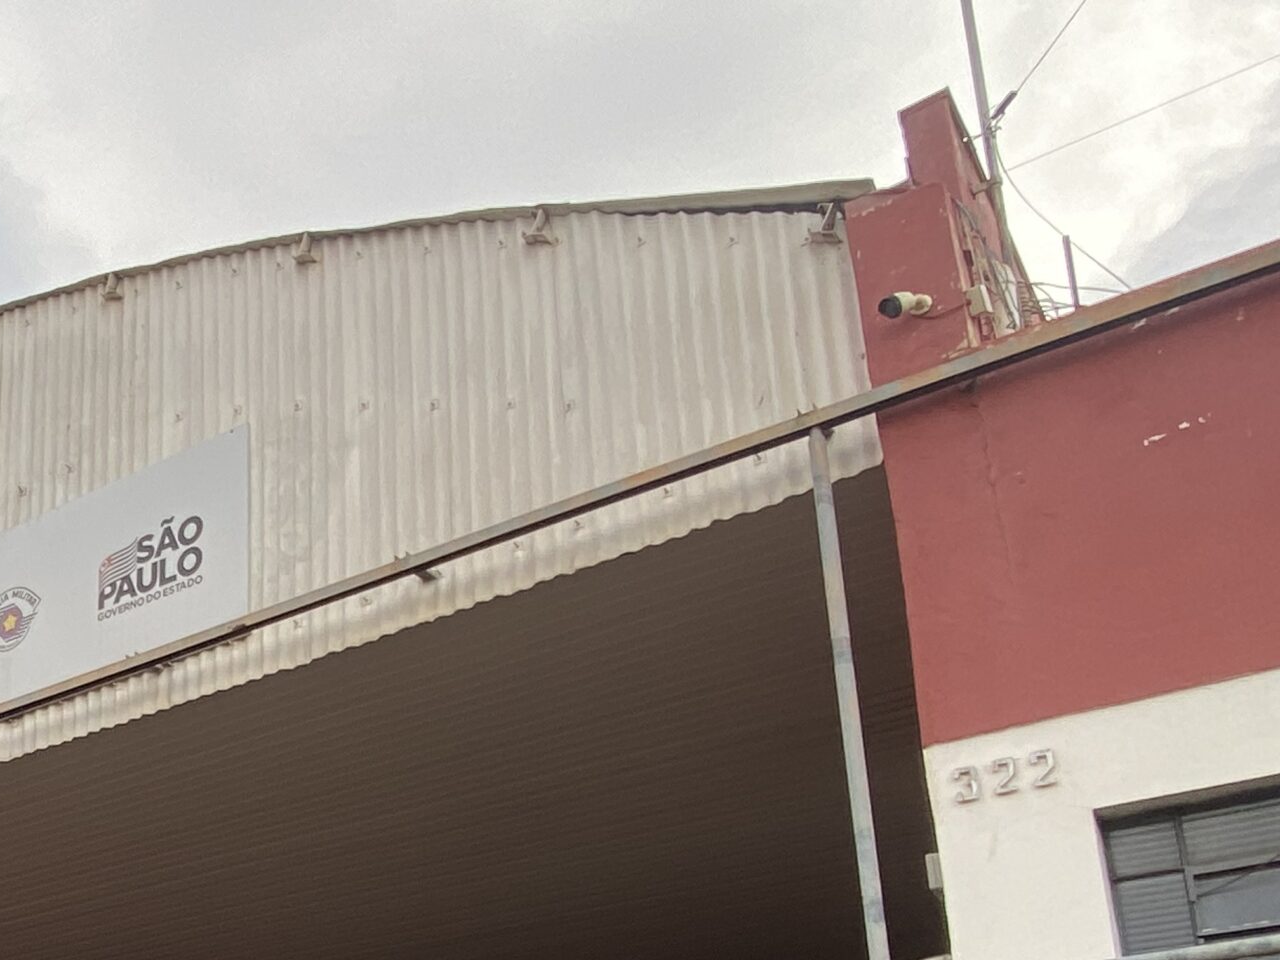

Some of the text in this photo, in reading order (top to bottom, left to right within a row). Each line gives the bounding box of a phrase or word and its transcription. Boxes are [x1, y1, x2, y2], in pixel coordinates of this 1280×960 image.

[136, 515, 204, 564] SÃO
[97, 575, 204, 622] GOVERNO DO ESTADO
[98, 546, 203, 611] PAULO
[952, 748, 1058, 804] 322
